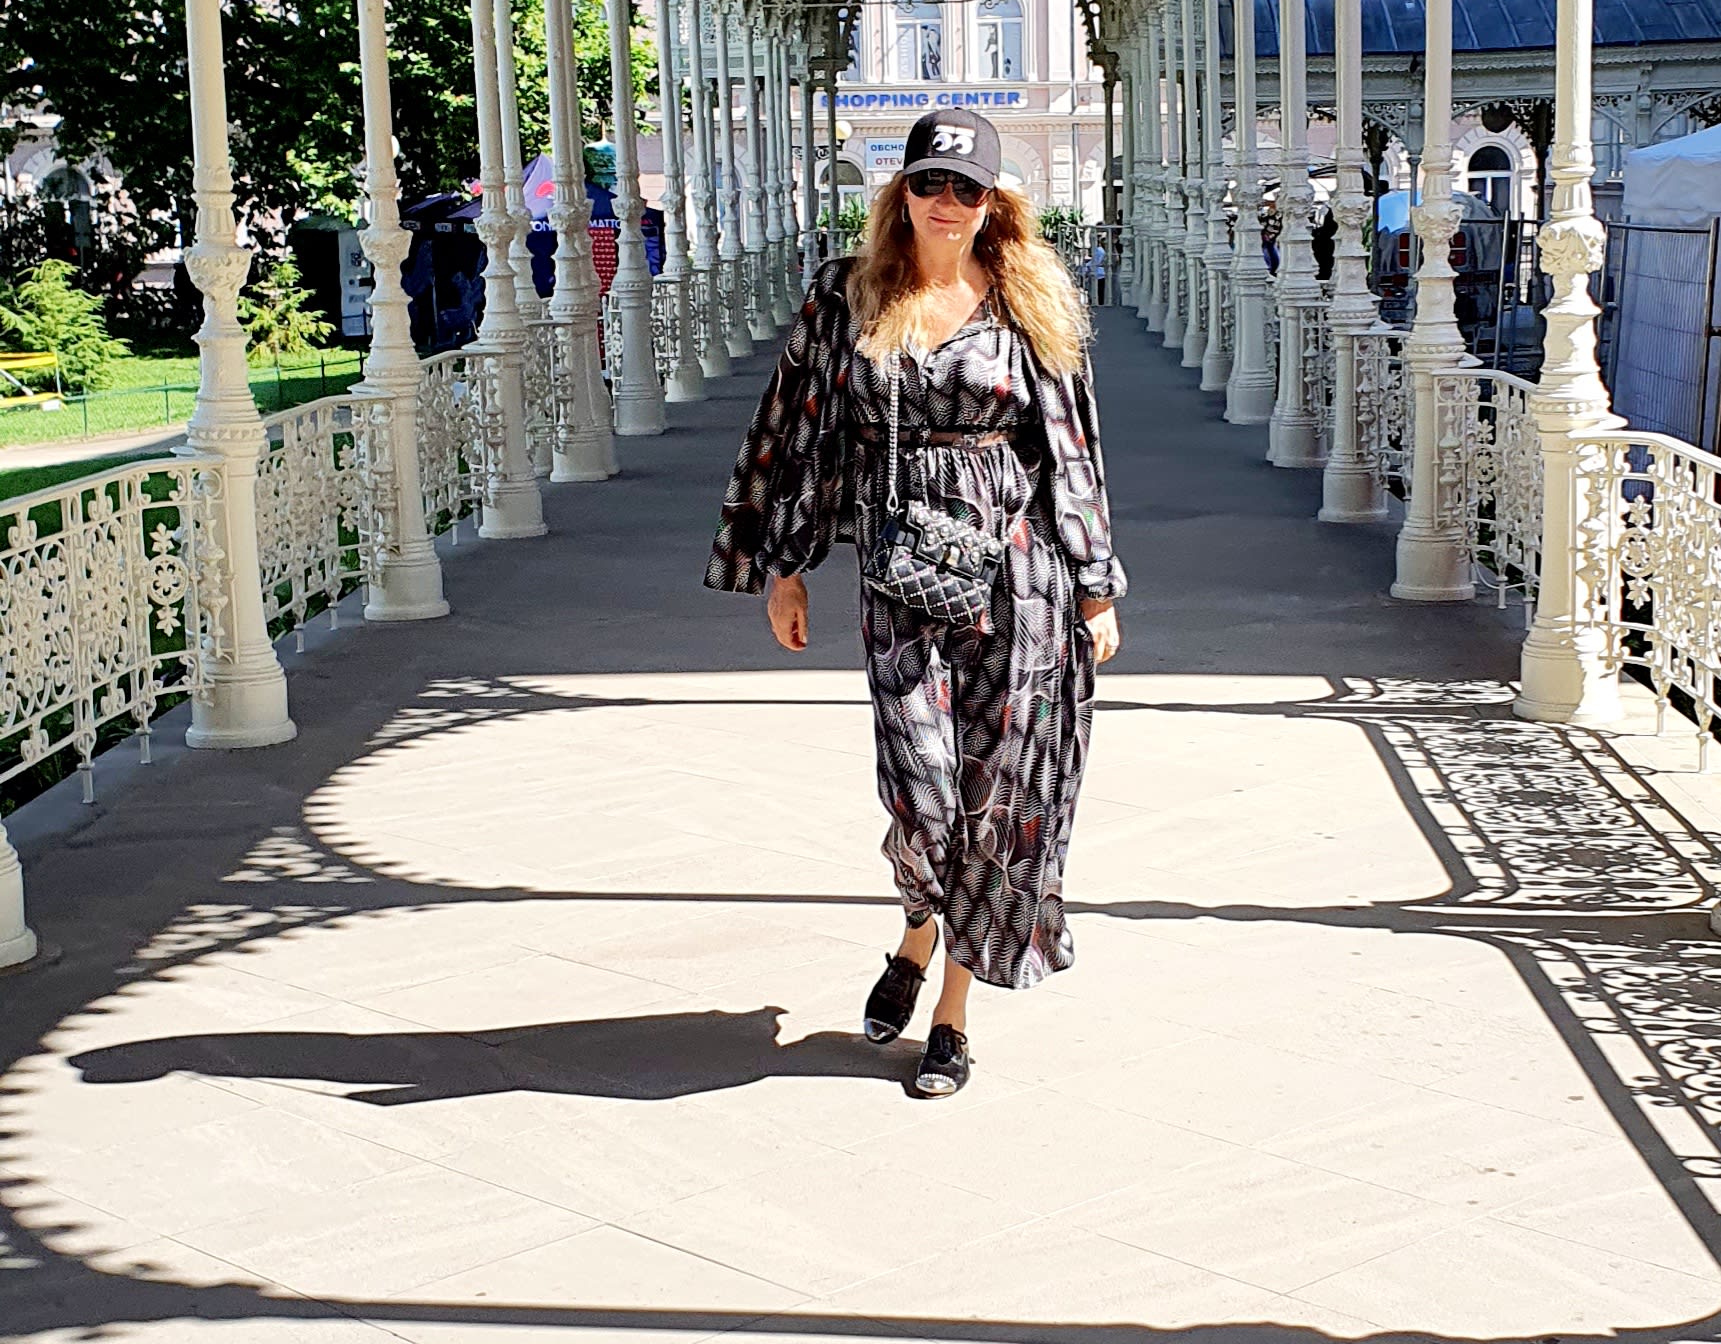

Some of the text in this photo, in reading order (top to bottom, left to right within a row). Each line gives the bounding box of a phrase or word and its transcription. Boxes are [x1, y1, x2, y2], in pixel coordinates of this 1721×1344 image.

[821, 92, 1021, 107] SHOPPING CENTER
[870, 143, 905, 152] OBCHO
[875, 157, 903, 166] OTEV
[588, 218, 621, 229] MATTO
